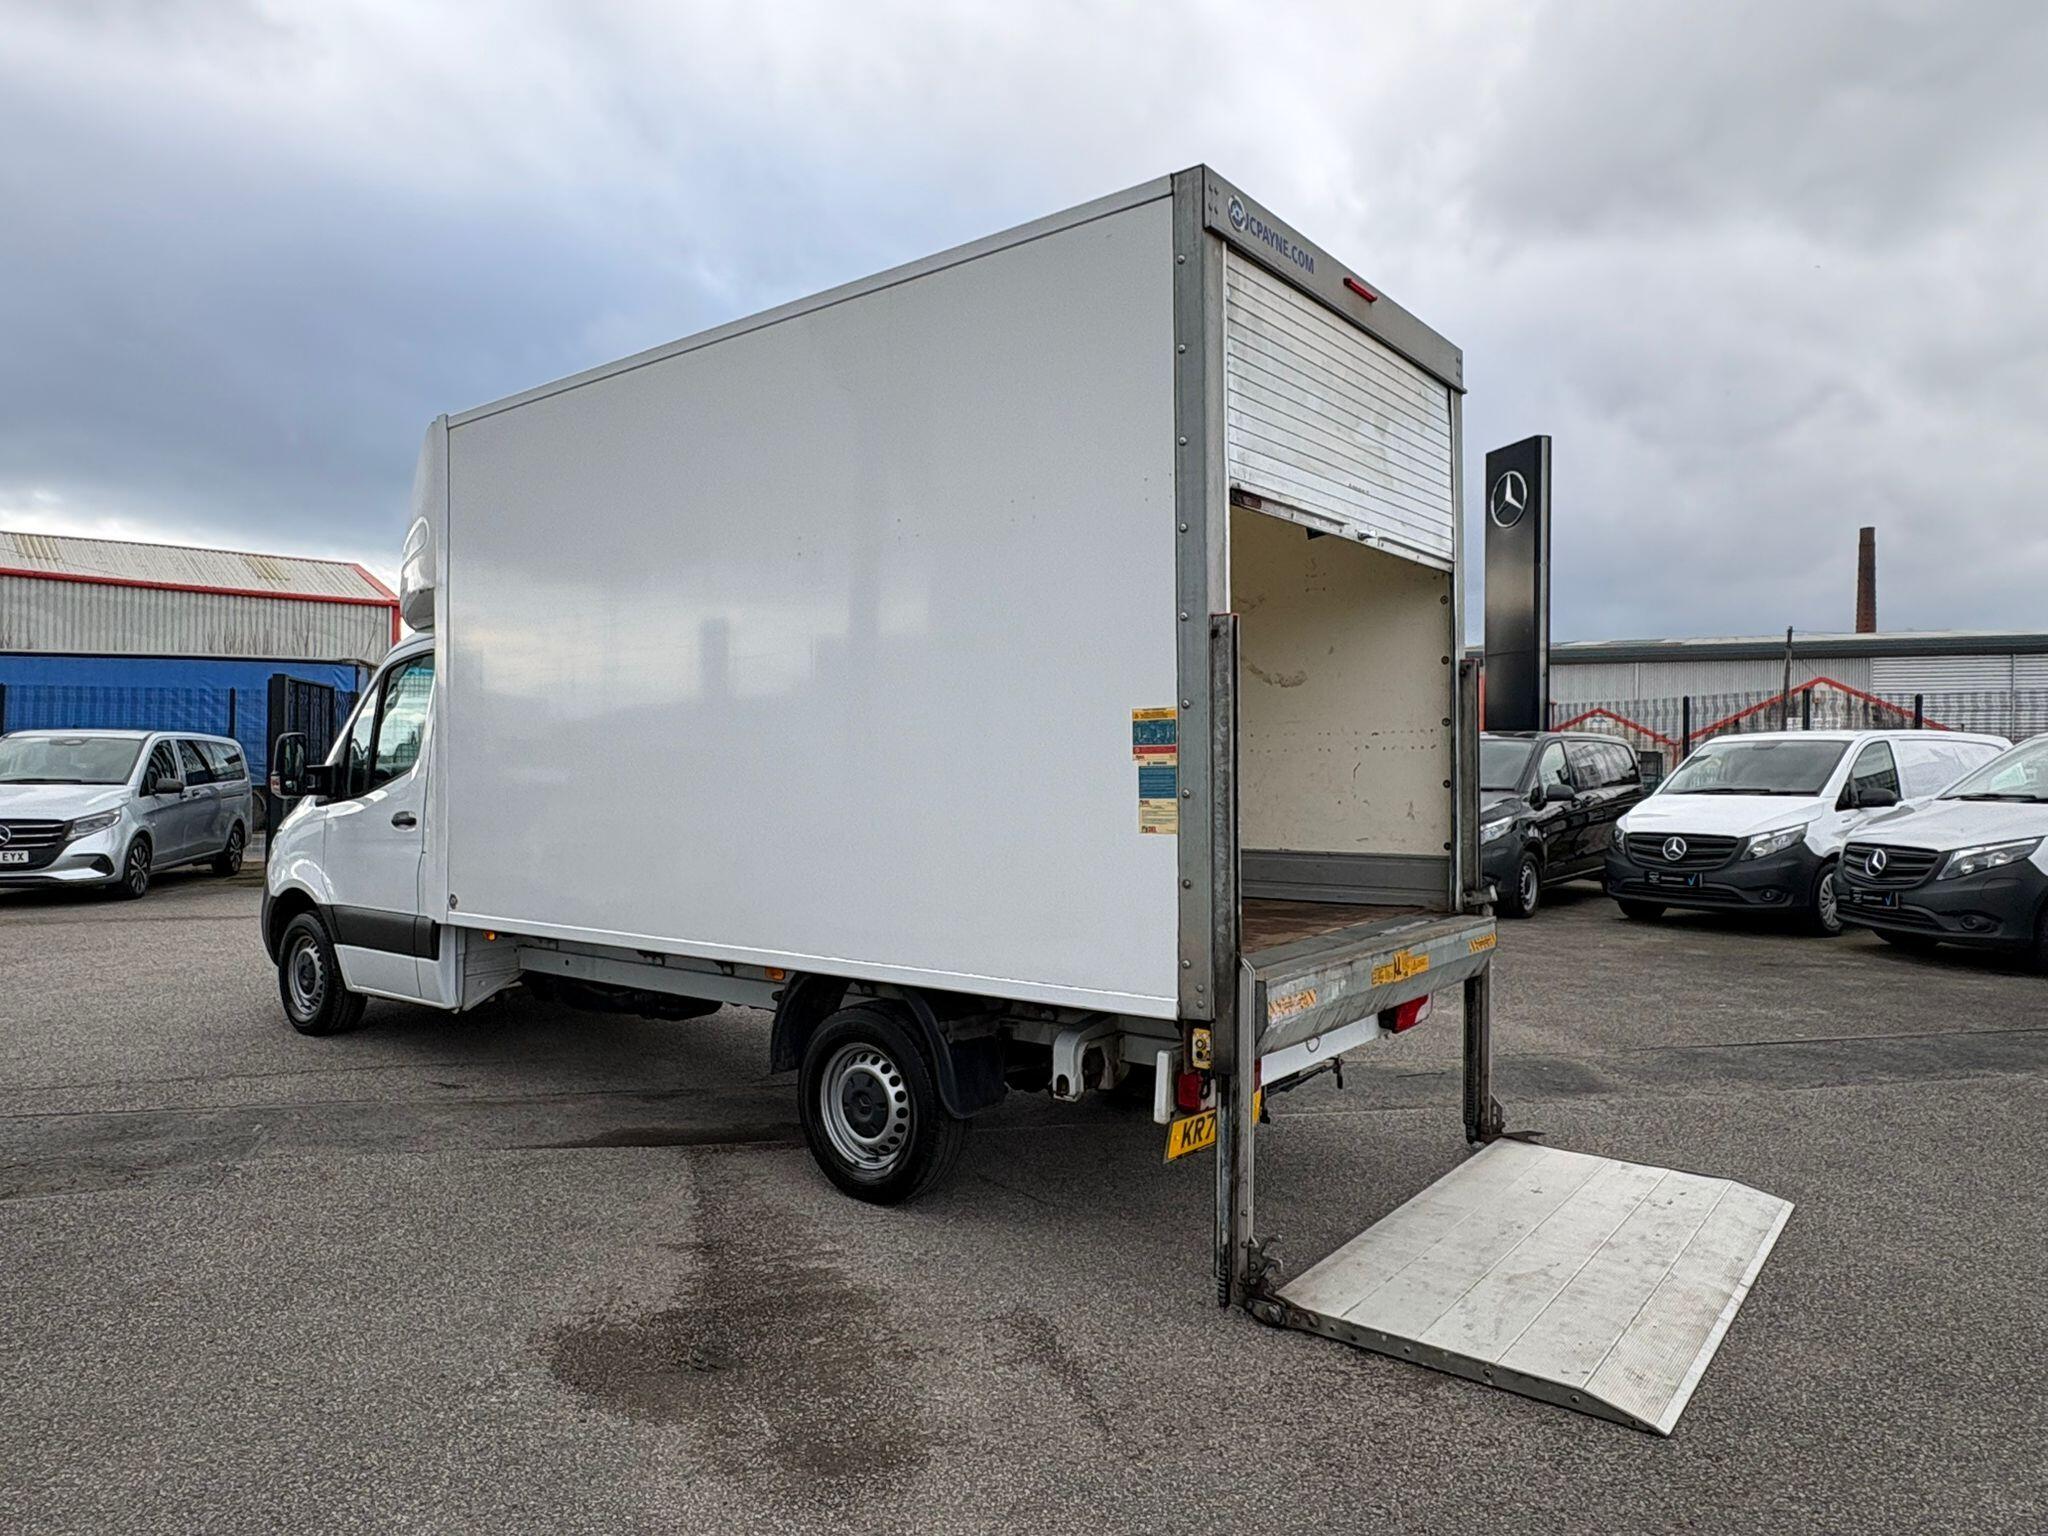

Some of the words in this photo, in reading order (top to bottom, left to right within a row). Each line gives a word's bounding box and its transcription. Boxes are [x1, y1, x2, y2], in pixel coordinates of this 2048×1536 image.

[1245, 211, 1314, 274] JCPAYNE.COM
[2, 852, 24, 861] EYX
[1181, 1113, 1216, 1149] KR7
